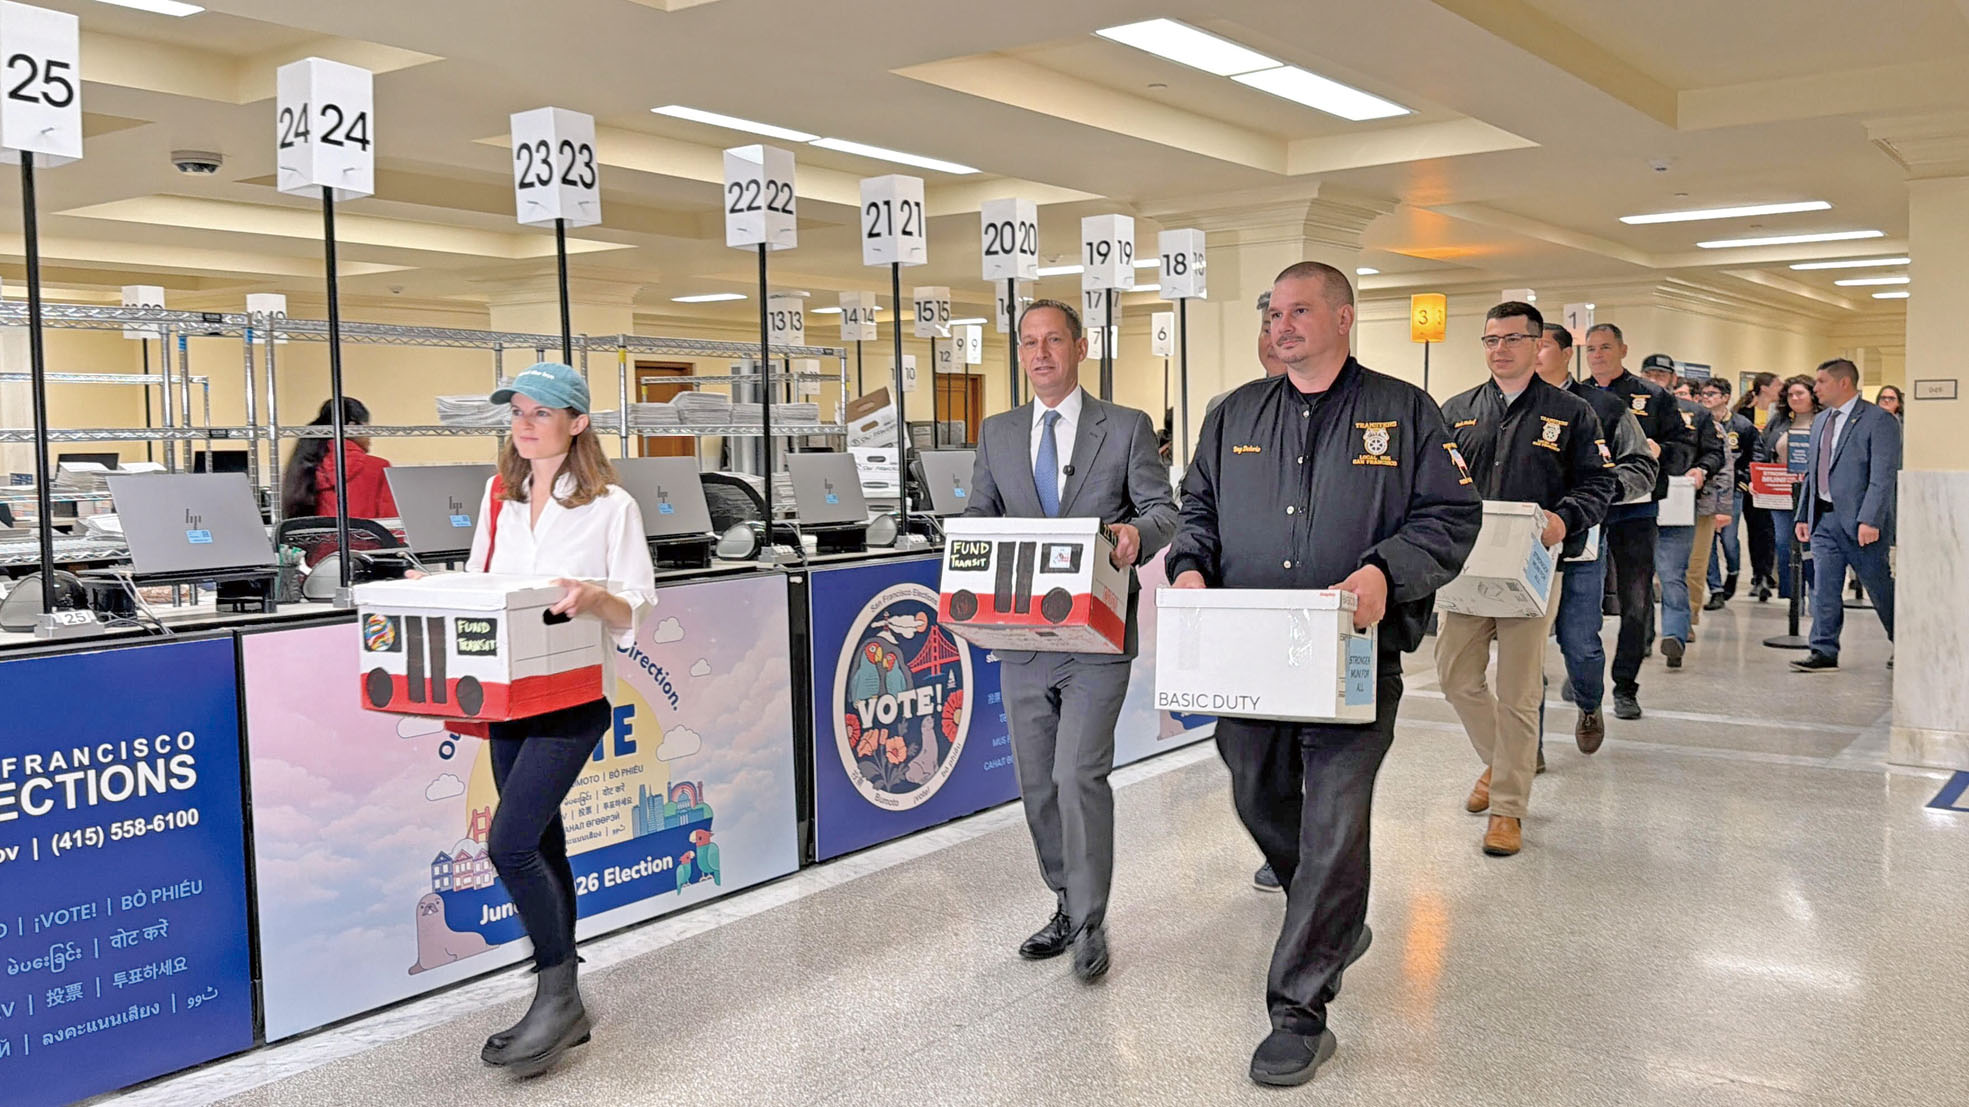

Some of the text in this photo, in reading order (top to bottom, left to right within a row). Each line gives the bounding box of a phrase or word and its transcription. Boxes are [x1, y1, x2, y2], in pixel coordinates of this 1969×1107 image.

[7, 53, 74, 108] 25
[279, 103, 310, 149] 24
[320, 104, 370, 152] 24
[516, 139, 554, 190] 23
[559, 139, 596, 190] 23
[728, 179, 761, 214] 22
[766, 179, 794, 215] 22
[866, 200, 893, 238] 21
[901, 199, 923, 238] 21
[984, 221, 1015, 256] 20
[1019, 221, 1037, 256] 20
[1086, 240, 1111, 266] 19
[1117, 239, 1132, 266] 19
[1162, 253, 1187, 276] 18
[936, 300, 950, 321] 15
[1085, 291, 1103, 309] 17
[769, 311, 786, 331] 13
[787, 310, 803, 331] 13
[843, 308, 858, 324] 14
[863, 308, 875, 323] 14
[915, 301, 934, 322] 15
[1418, 310, 1428, 325] 3
[1568, 311, 1577, 329] 1
[956, 338, 964, 351] 9
[1093, 331, 1101, 345] 7
[1157, 327, 1167, 341] 6
[971, 339, 978, 351] 9
[939, 351, 951, 363] 12
[905, 367, 916, 380] 10
[953, 542, 990, 555] FUND
[62, 611, 88, 624] 25
[457, 620, 491, 634] FUND
[1349, 656, 1370, 664] STRONGER
[857, 684, 942, 730] VOTE!
[1158, 692, 1260, 710] BASIC DUTY
[2, 731, 195, 779] FRANCISCO
[572, 775, 600, 788] MOTO
[874, 793, 899, 807] Bumoto
[51, 826, 105, 857] (415)
[110, 808, 200, 841] 558-6100
[604, 854, 673, 889] Election
[34, 902, 97, 934] ¡VOTE!
[110, 929, 139, 948] वोट
[113, 956, 188, 989] 투표하세요
[46, 982, 84, 1007] 投票
[42, 1004, 160, 1046] ลงคะแนนเสียง
